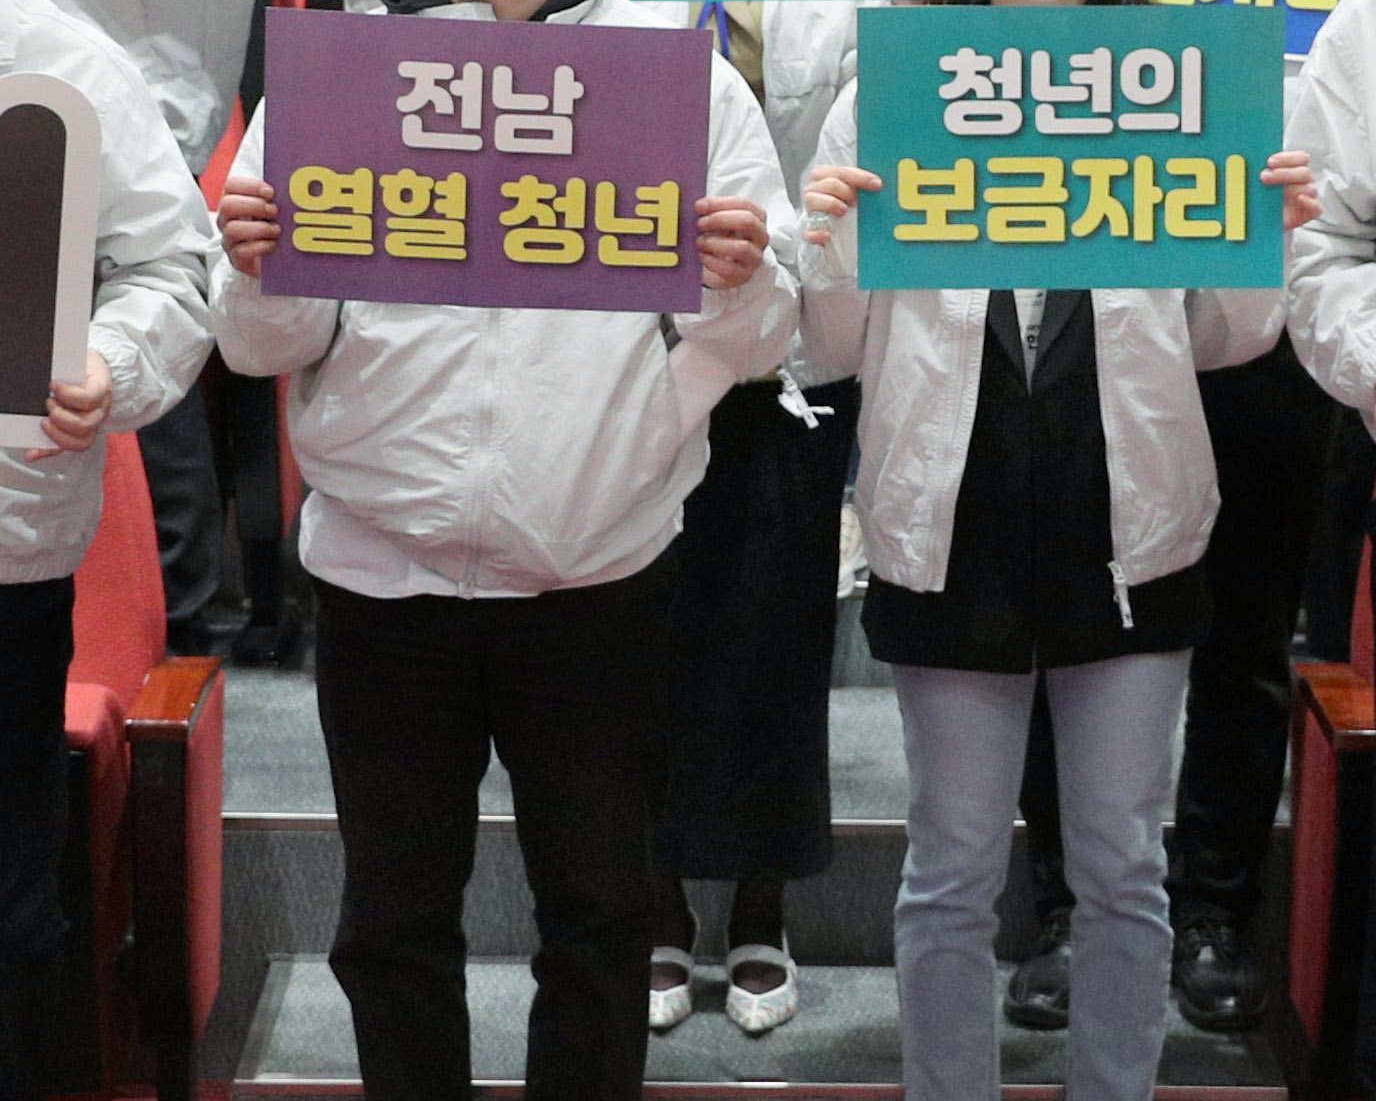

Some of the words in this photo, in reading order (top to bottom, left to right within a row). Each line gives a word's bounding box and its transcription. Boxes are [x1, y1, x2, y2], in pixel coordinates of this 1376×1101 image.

[395, 60, 585, 155] 전남
[937, 46, 1203, 137] 청년의
[288, 166, 467, 260] 열혈
[499, 175, 680, 268] 청년
[893, 154, 1246, 243] 보금자리
